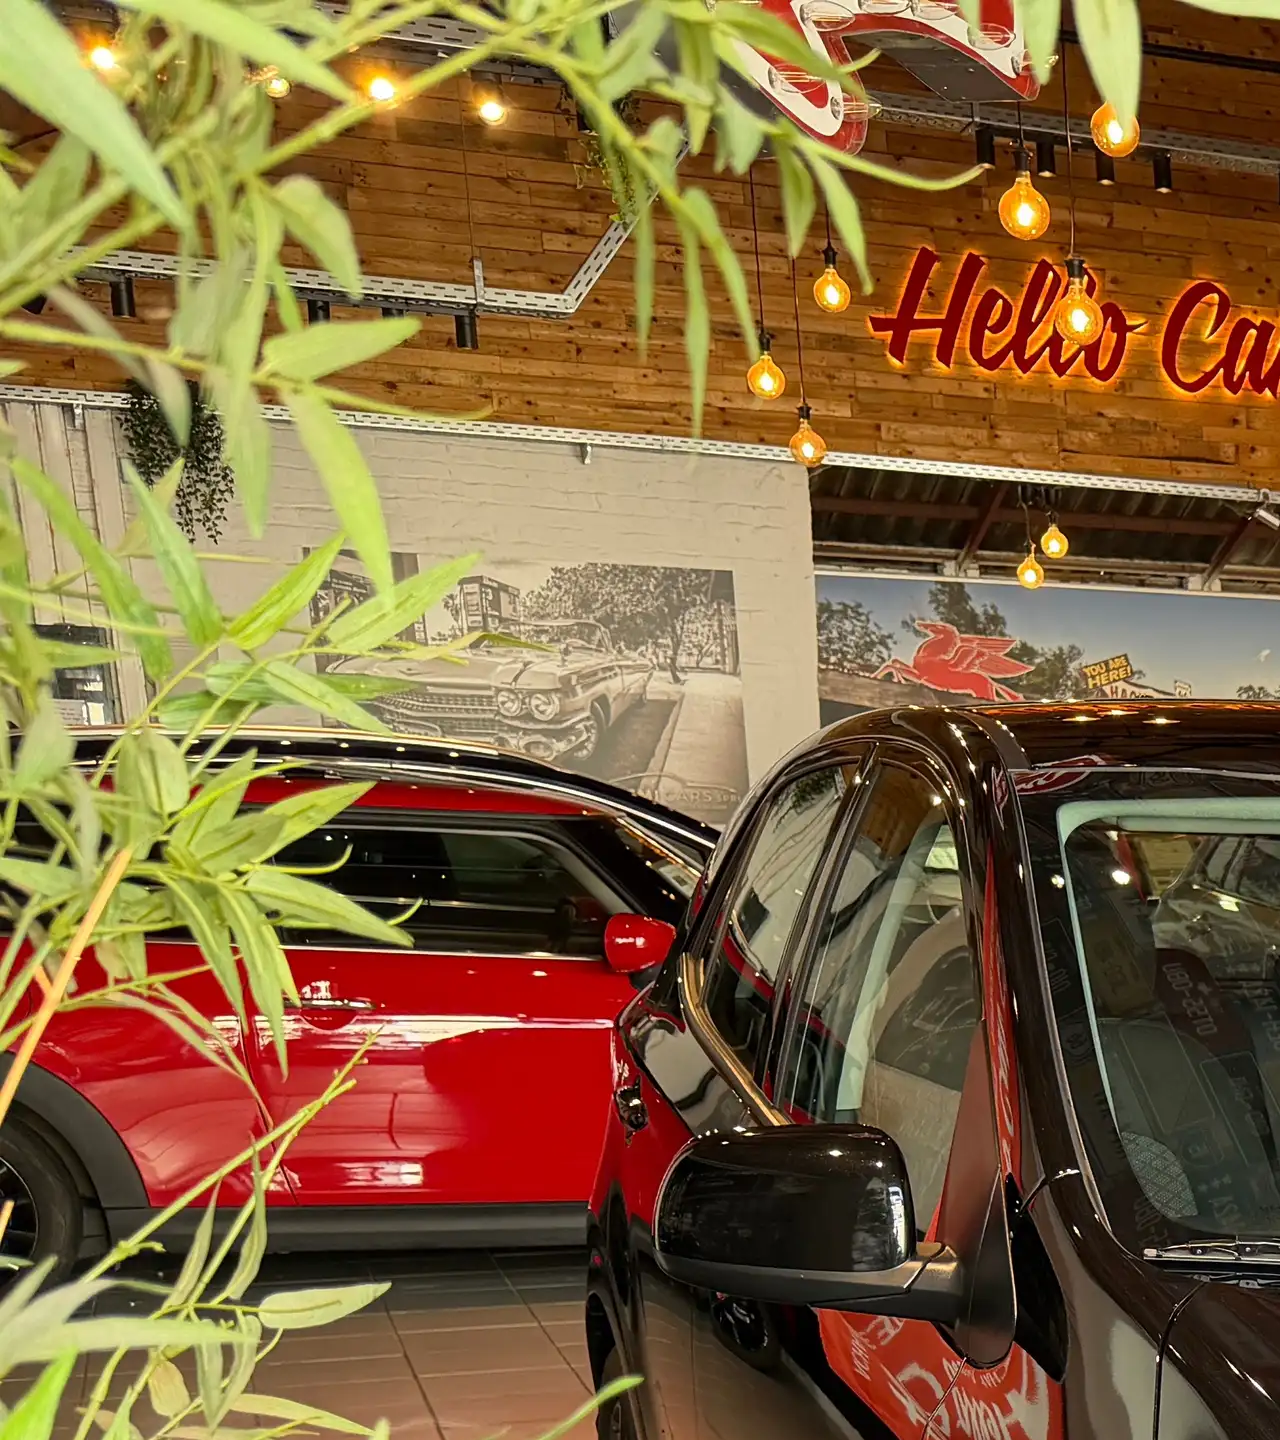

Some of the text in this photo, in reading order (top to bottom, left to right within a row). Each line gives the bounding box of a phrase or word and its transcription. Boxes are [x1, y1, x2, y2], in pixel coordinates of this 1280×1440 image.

[869, 246, 1149, 383] Hello
[1083, 656, 1129, 678] YOU ARE
[1088, 665, 1132, 689] HERE!
